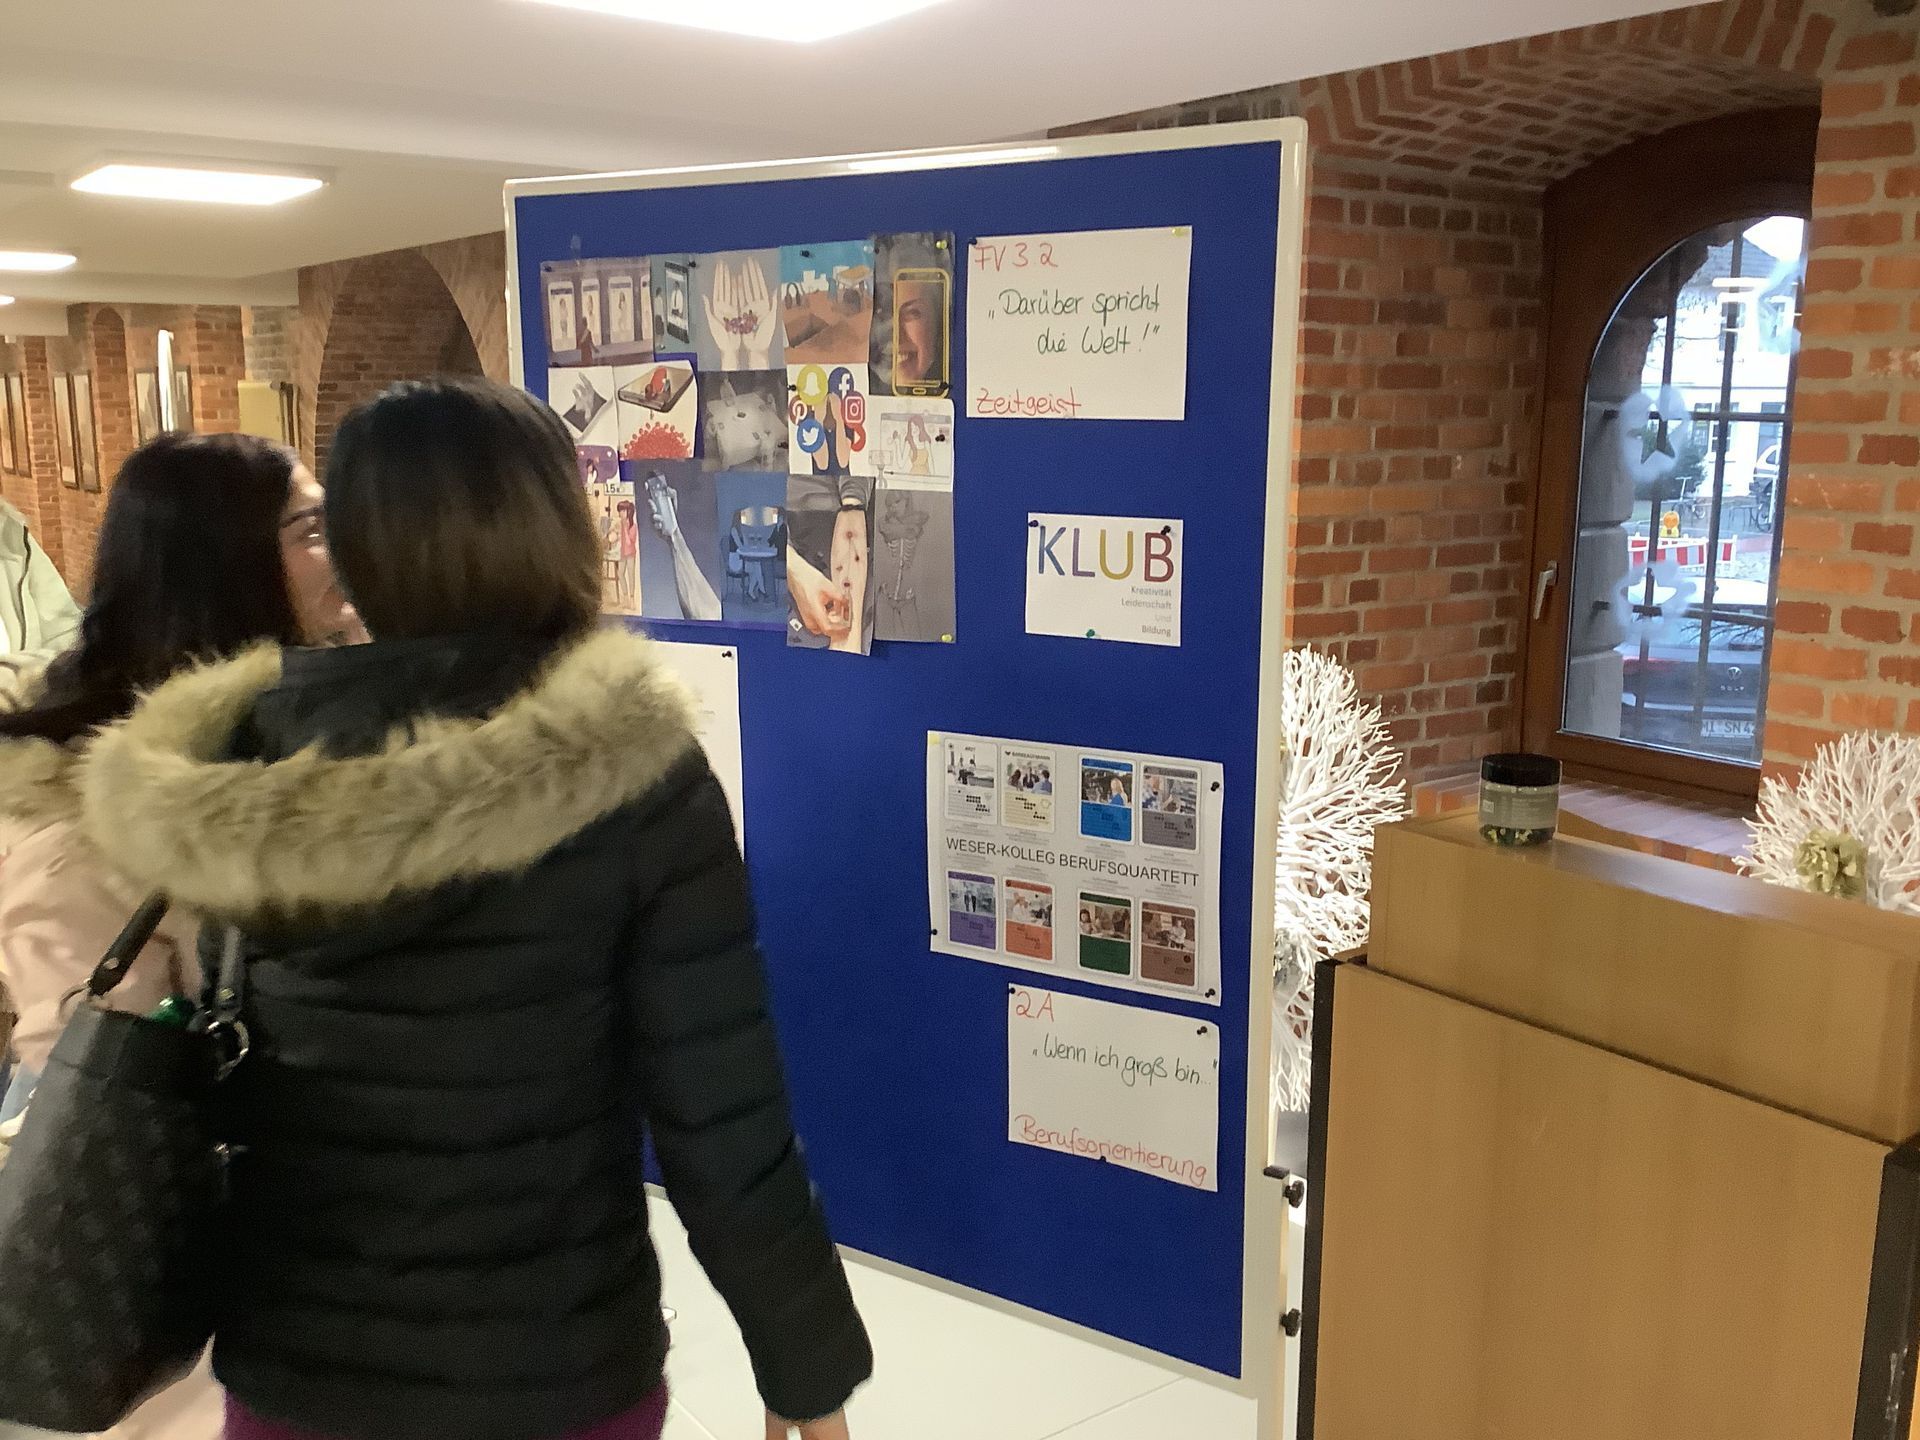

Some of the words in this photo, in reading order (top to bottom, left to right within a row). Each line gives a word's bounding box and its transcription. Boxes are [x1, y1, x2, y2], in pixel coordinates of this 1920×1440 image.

[974, 244, 1007, 272] FV
[1092, 284, 1160, 326] spricht
[1037, 328, 1068, 355] die
[976, 386, 1082, 416] Zeitgeist
[1038, 525, 1175, 582] KLUB
[1121, 598, 1172, 609] Leidenschaft
[1142, 625, 1171, 637] Bildung
[1724, 721, 1741, 734] SN
[946, 837, 1056, 865] WESER-KOLLEG
[1059, 853, 1200, 888] BERUFSQUARTETT
[1094, 1045, 1119, 1069] ich
[1121, 1055, 1167, 1088] groß
[1015, 1114, 1207, 1187] Berufsorientierung
